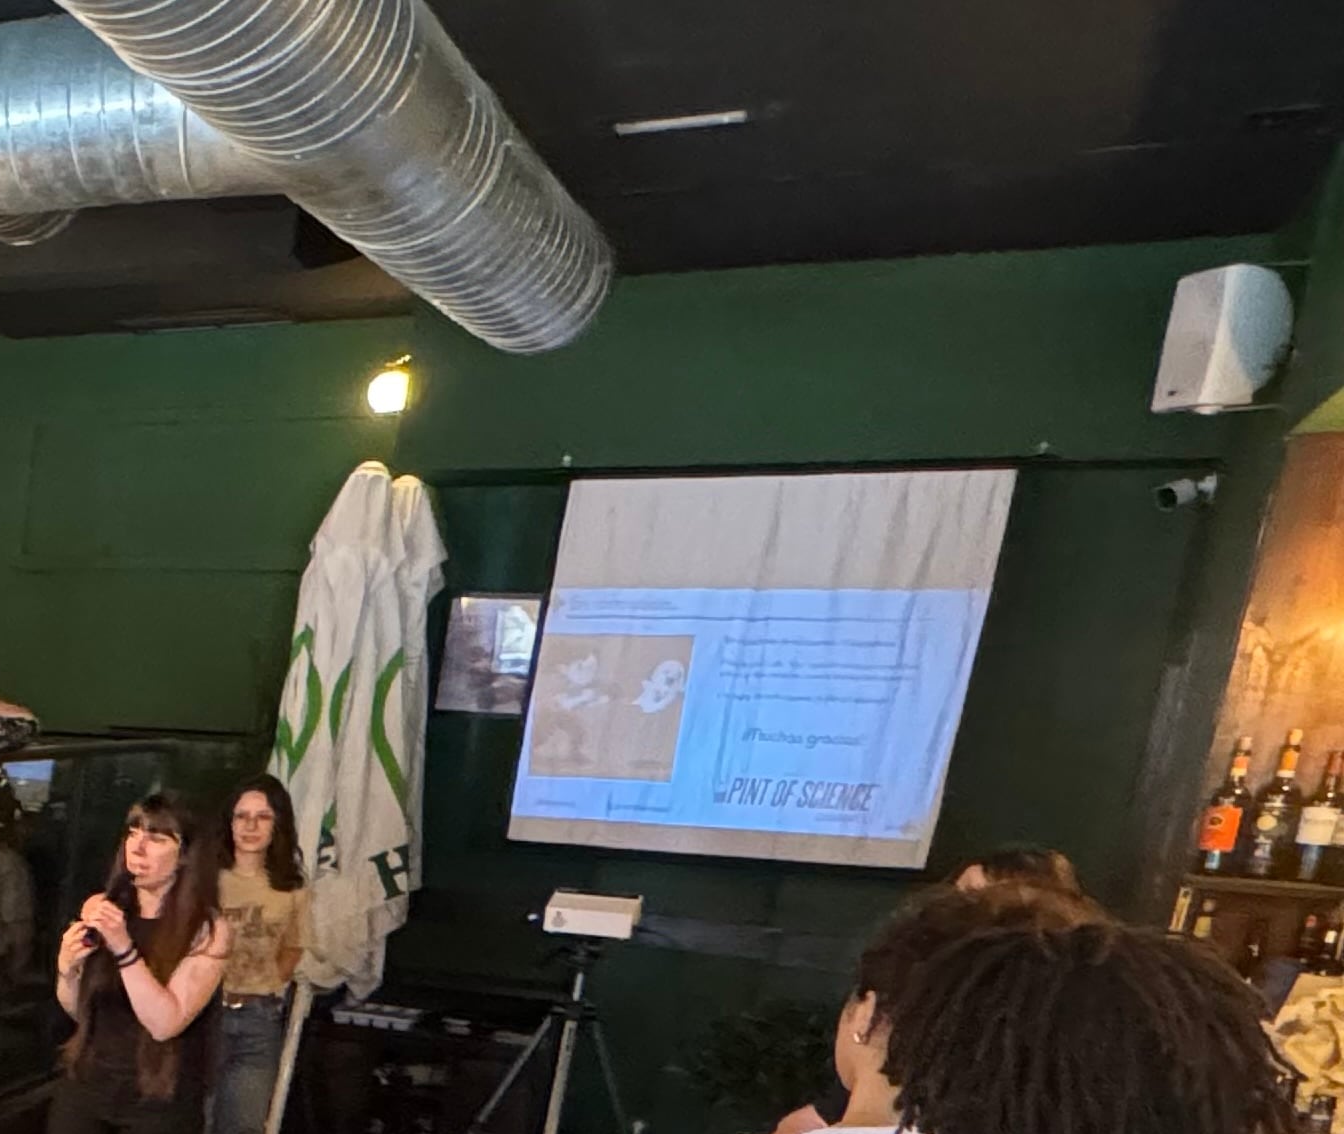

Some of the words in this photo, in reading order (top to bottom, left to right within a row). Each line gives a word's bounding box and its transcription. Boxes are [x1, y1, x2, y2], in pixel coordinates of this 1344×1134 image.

[727, 778, 773, 805] PINT
[774, 780, 798, 807] OF
[797, 782, 879, 811] SCIENCE
